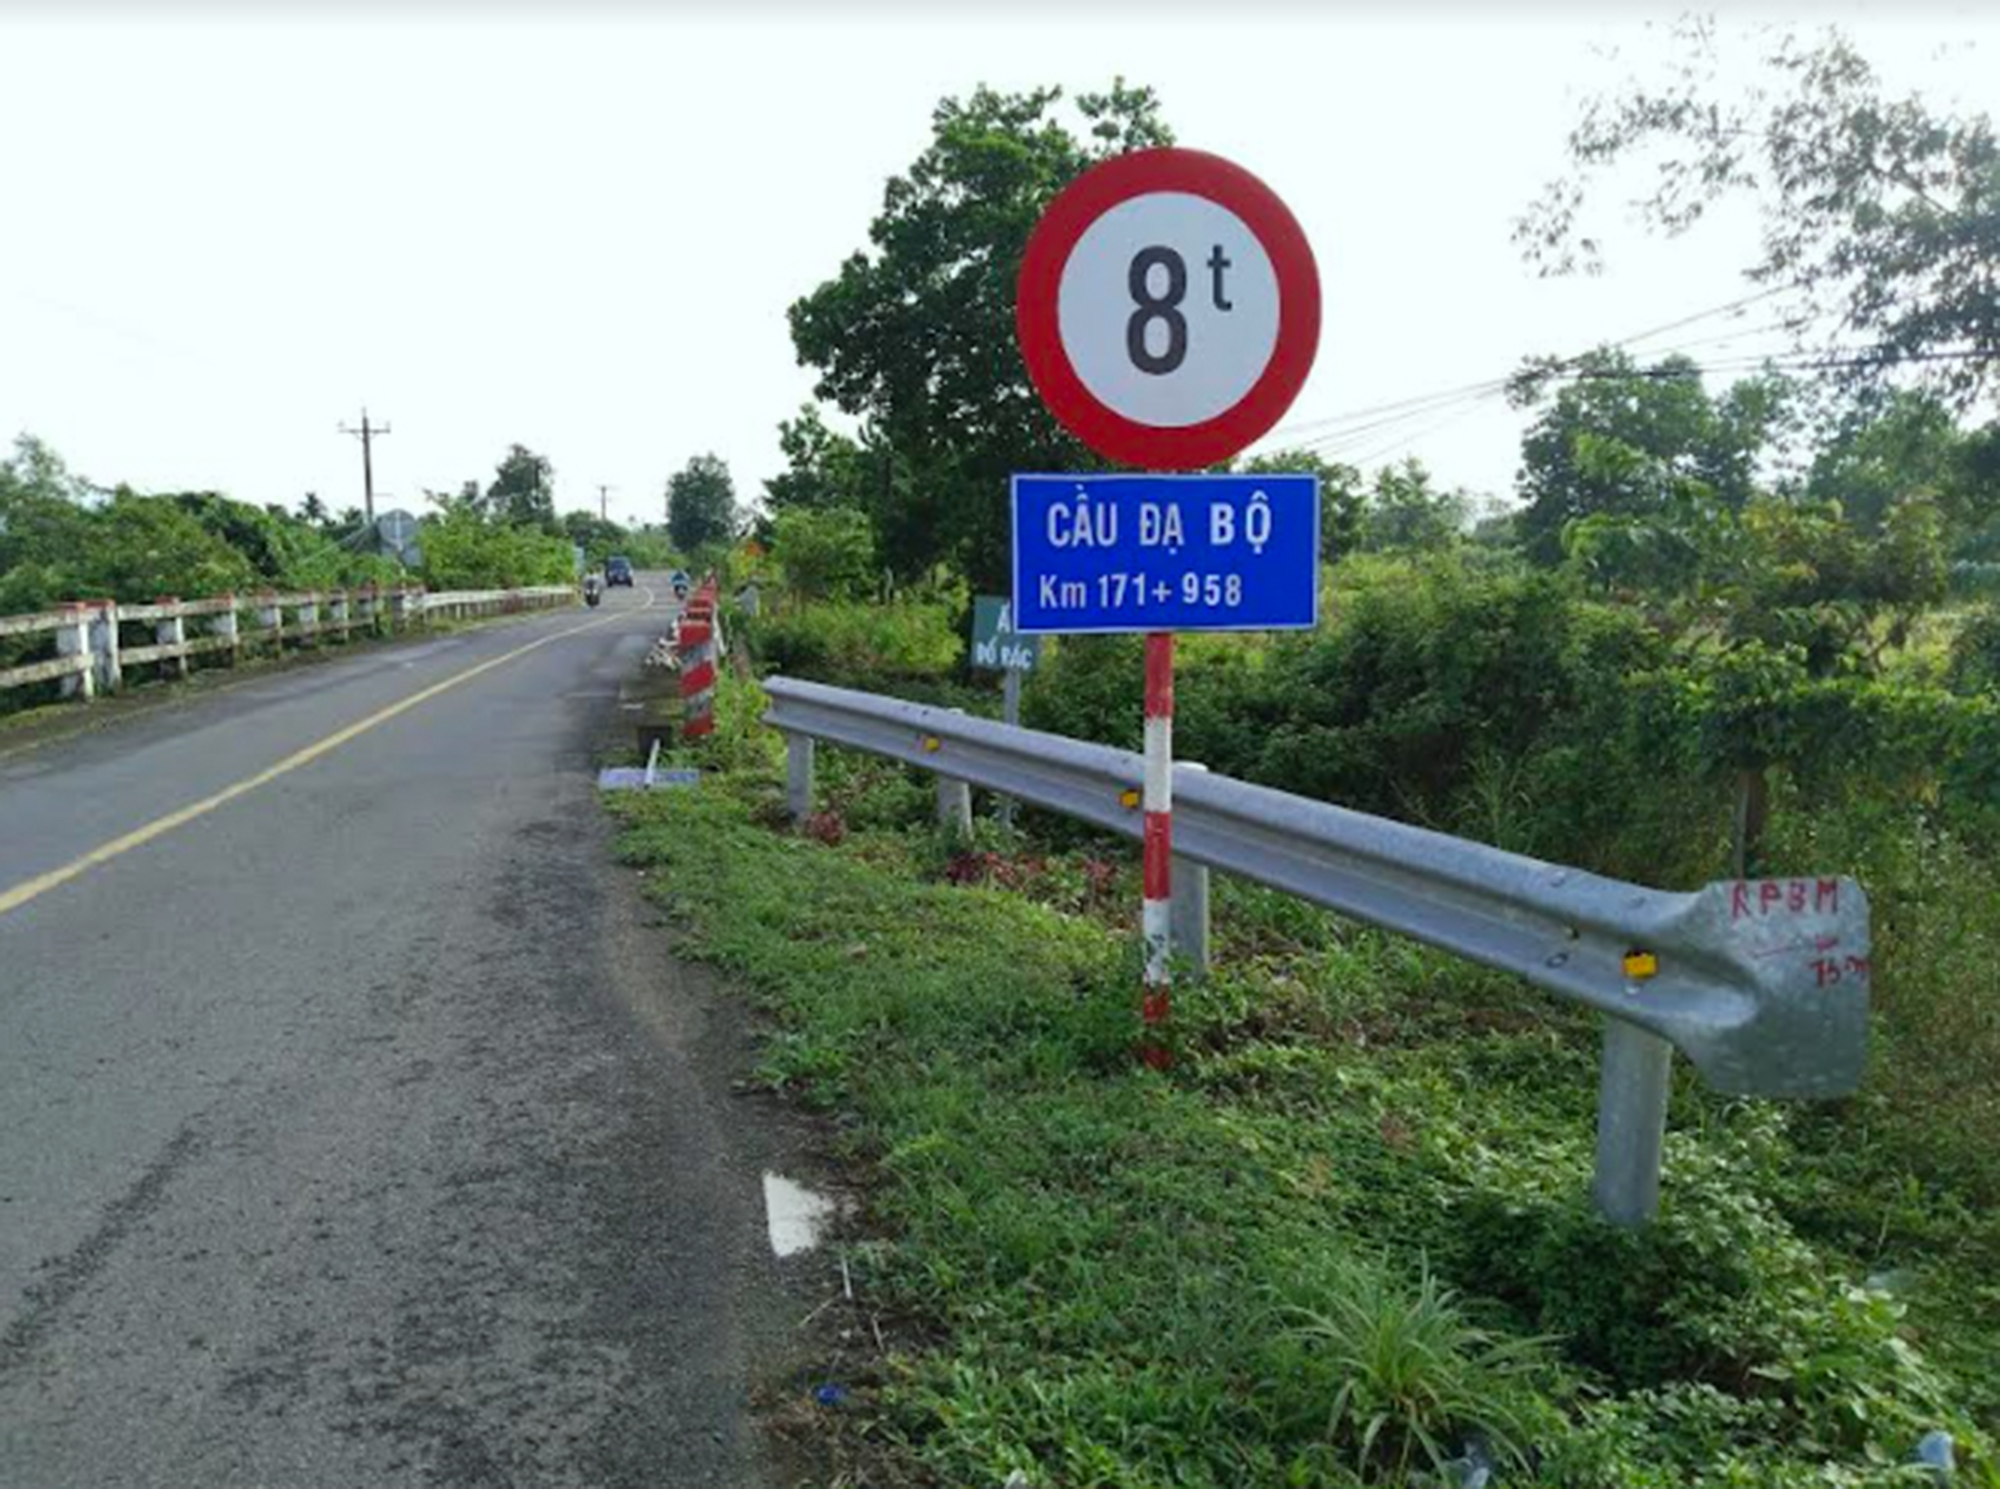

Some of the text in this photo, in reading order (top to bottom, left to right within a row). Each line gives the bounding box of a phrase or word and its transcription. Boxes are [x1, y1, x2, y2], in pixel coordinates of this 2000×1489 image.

[1047, 484, 1272, 555] CẦU ĐẠ BỘ
[1039, 573, 1087, 608] Km
